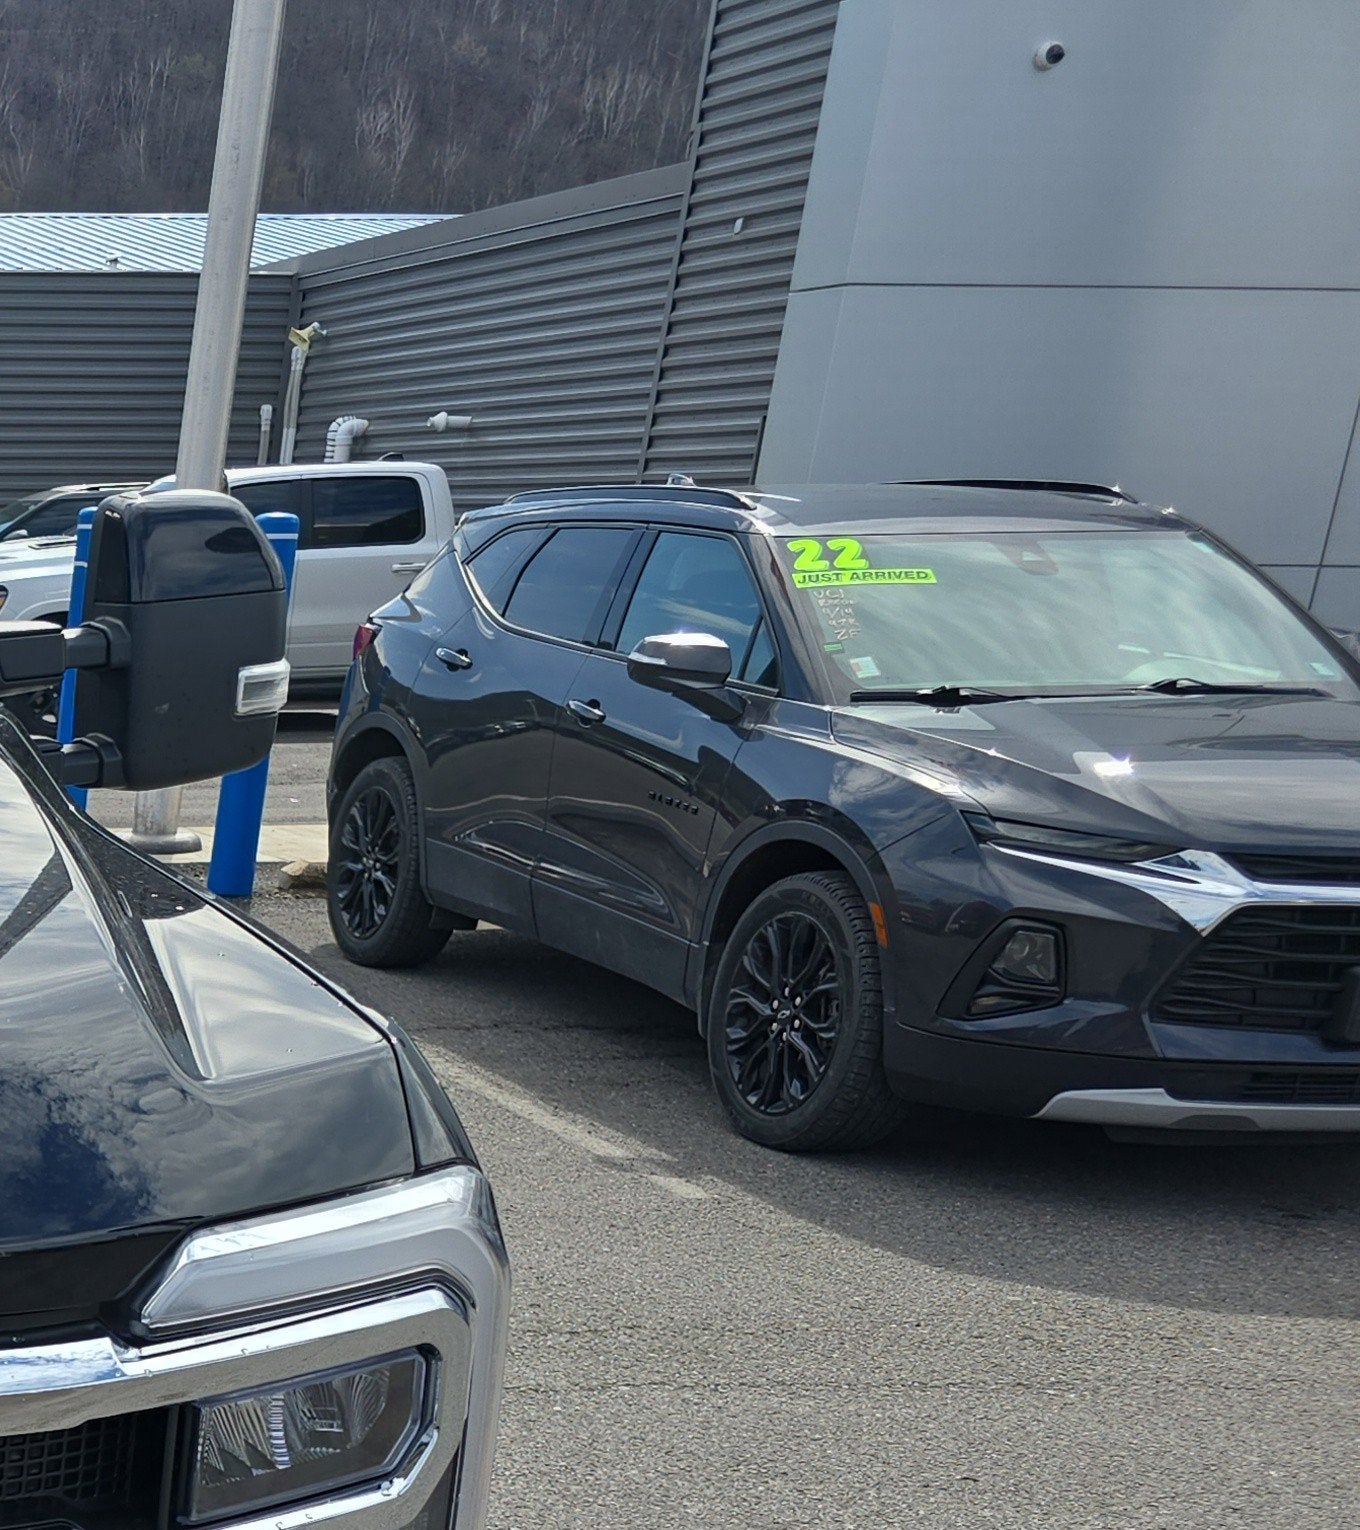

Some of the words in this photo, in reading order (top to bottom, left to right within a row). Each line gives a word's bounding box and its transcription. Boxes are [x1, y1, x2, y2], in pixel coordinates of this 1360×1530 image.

[786, 538, 869, 571] 22
[797, 572, 844, 584] JUST
[849, 570, 930, 581] ARRIVED
